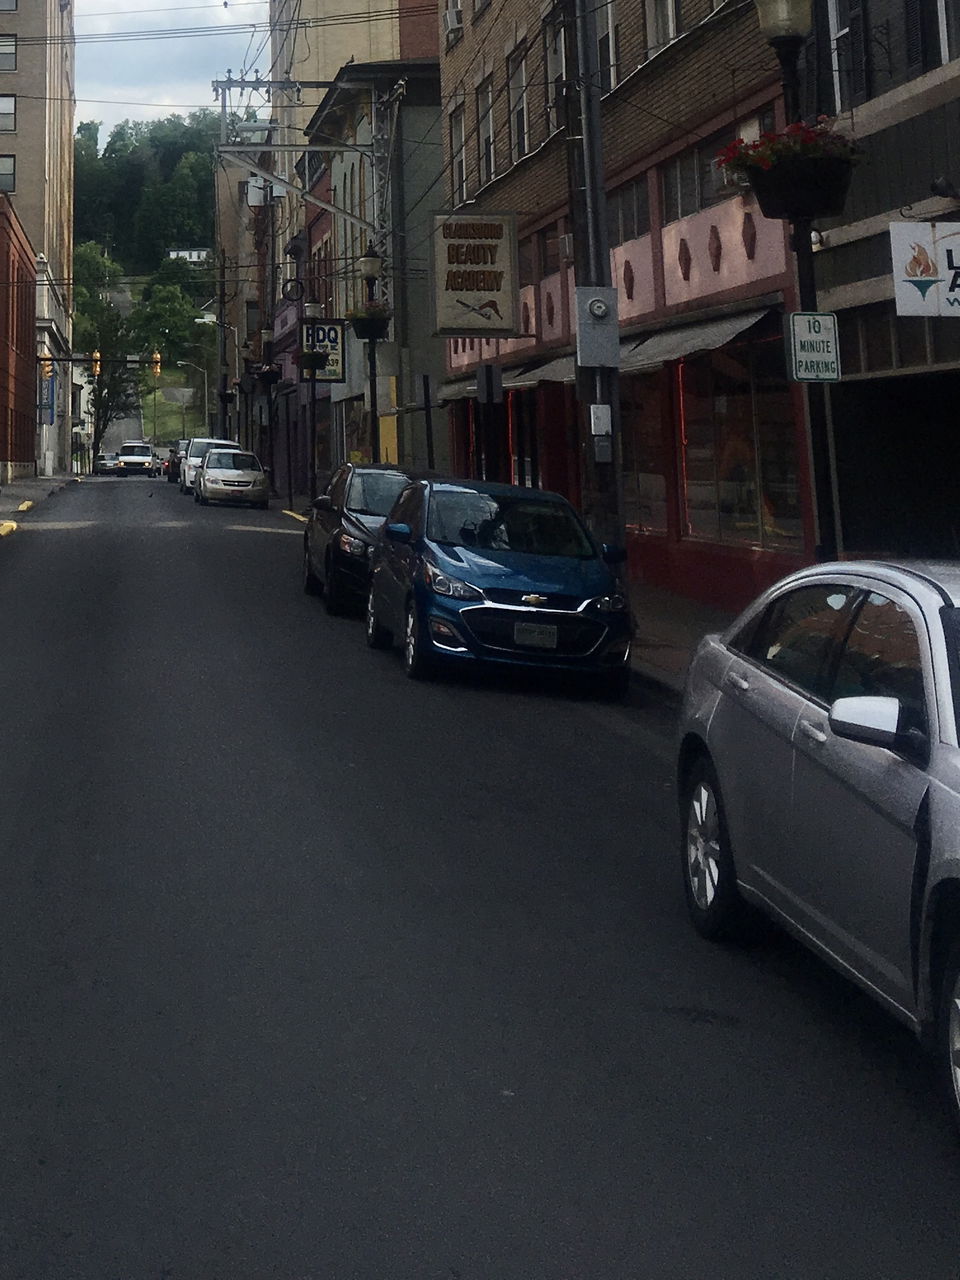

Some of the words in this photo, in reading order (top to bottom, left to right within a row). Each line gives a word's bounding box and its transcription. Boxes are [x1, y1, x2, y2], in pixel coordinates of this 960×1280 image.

[448, 244, 498, 265] BEAUTY
[445, 270, 504, 291] ACADEMY
[807, 319, 821, 334] 10
[800, 341, 831, 353] MINUTE
[798, 360, 836, 373] PARKING
